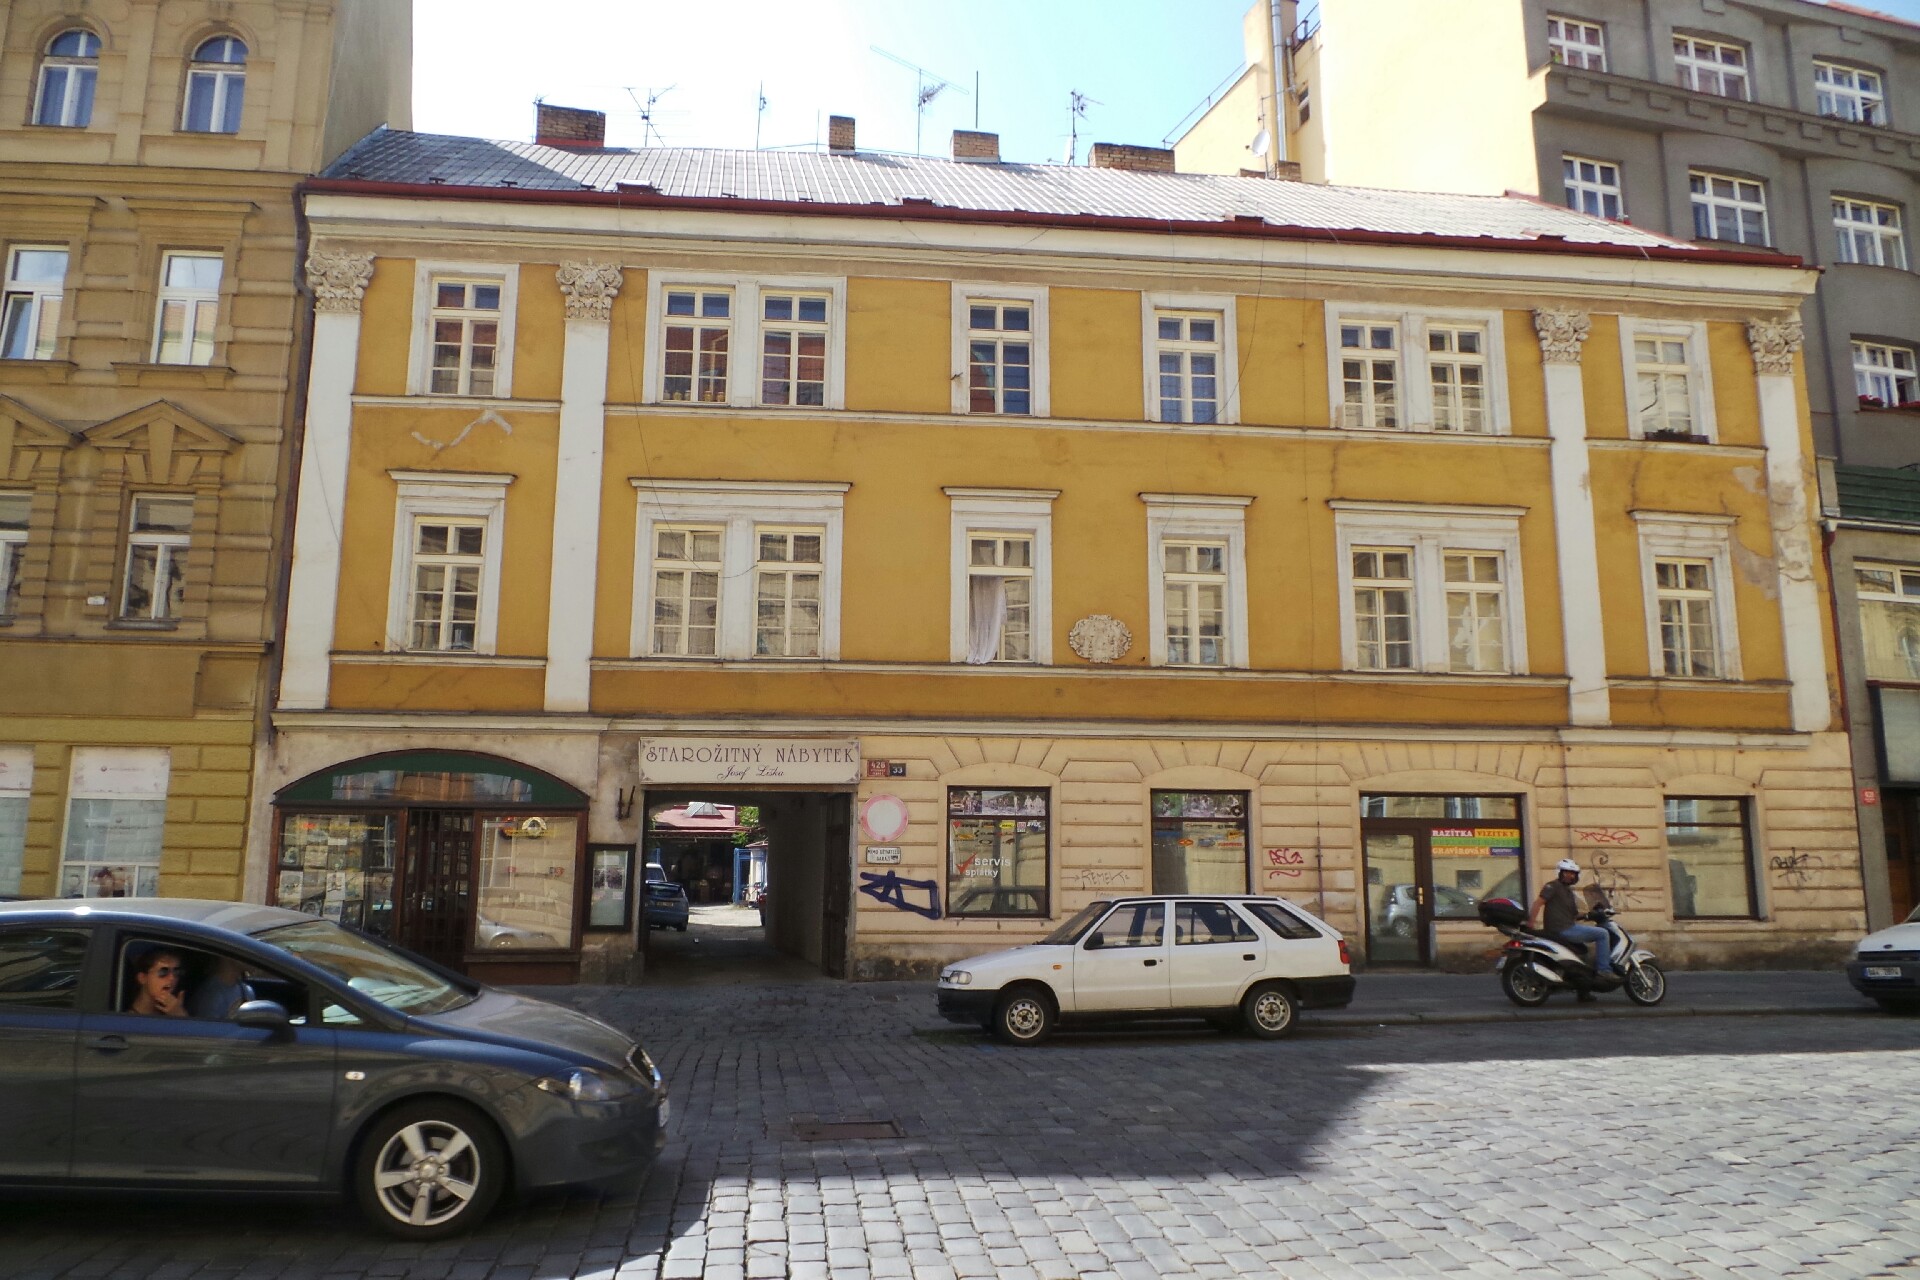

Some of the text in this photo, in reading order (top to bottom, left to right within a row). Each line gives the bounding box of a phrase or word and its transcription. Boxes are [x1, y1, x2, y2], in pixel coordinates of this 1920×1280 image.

[646, 743, 855, 763] STAROŽITNÝ NÁBYTEK
[717, 764, 751, 781] Josef
[892, 766, 903, 774] 33
[1432, 828, 1474, 837] RAZÍTKA
[974, 856, 1011, 867] servis
